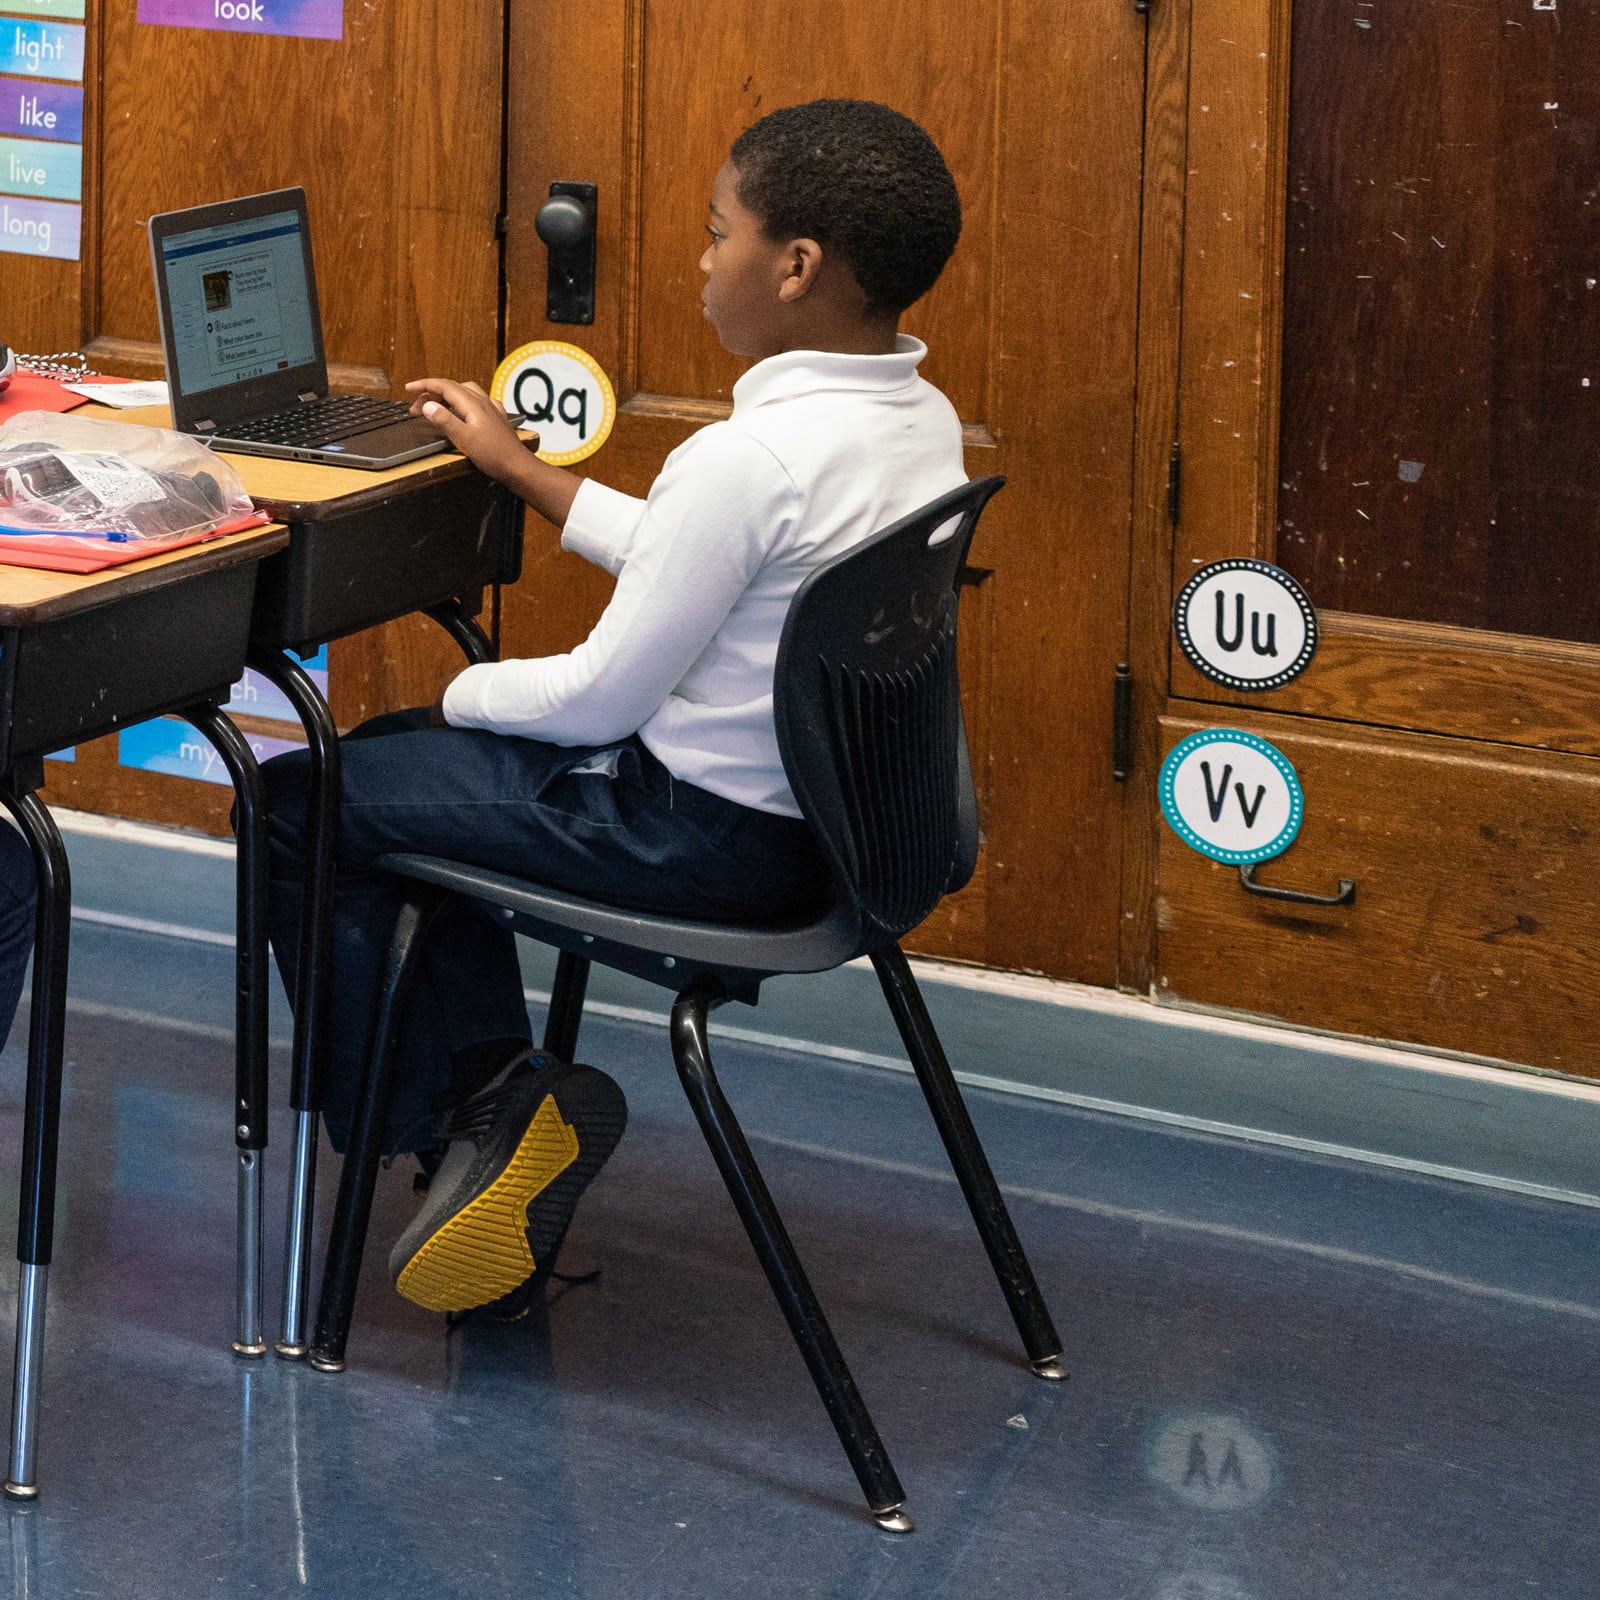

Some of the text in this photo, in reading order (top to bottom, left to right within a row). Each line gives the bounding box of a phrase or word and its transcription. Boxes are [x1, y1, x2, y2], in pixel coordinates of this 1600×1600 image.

[20, 95, 57, 128] like
[514, 367, 587, 439] Qq
[1216, 590, 1278, 657] Uu
[1200, 761, 1266, 828] Vv
